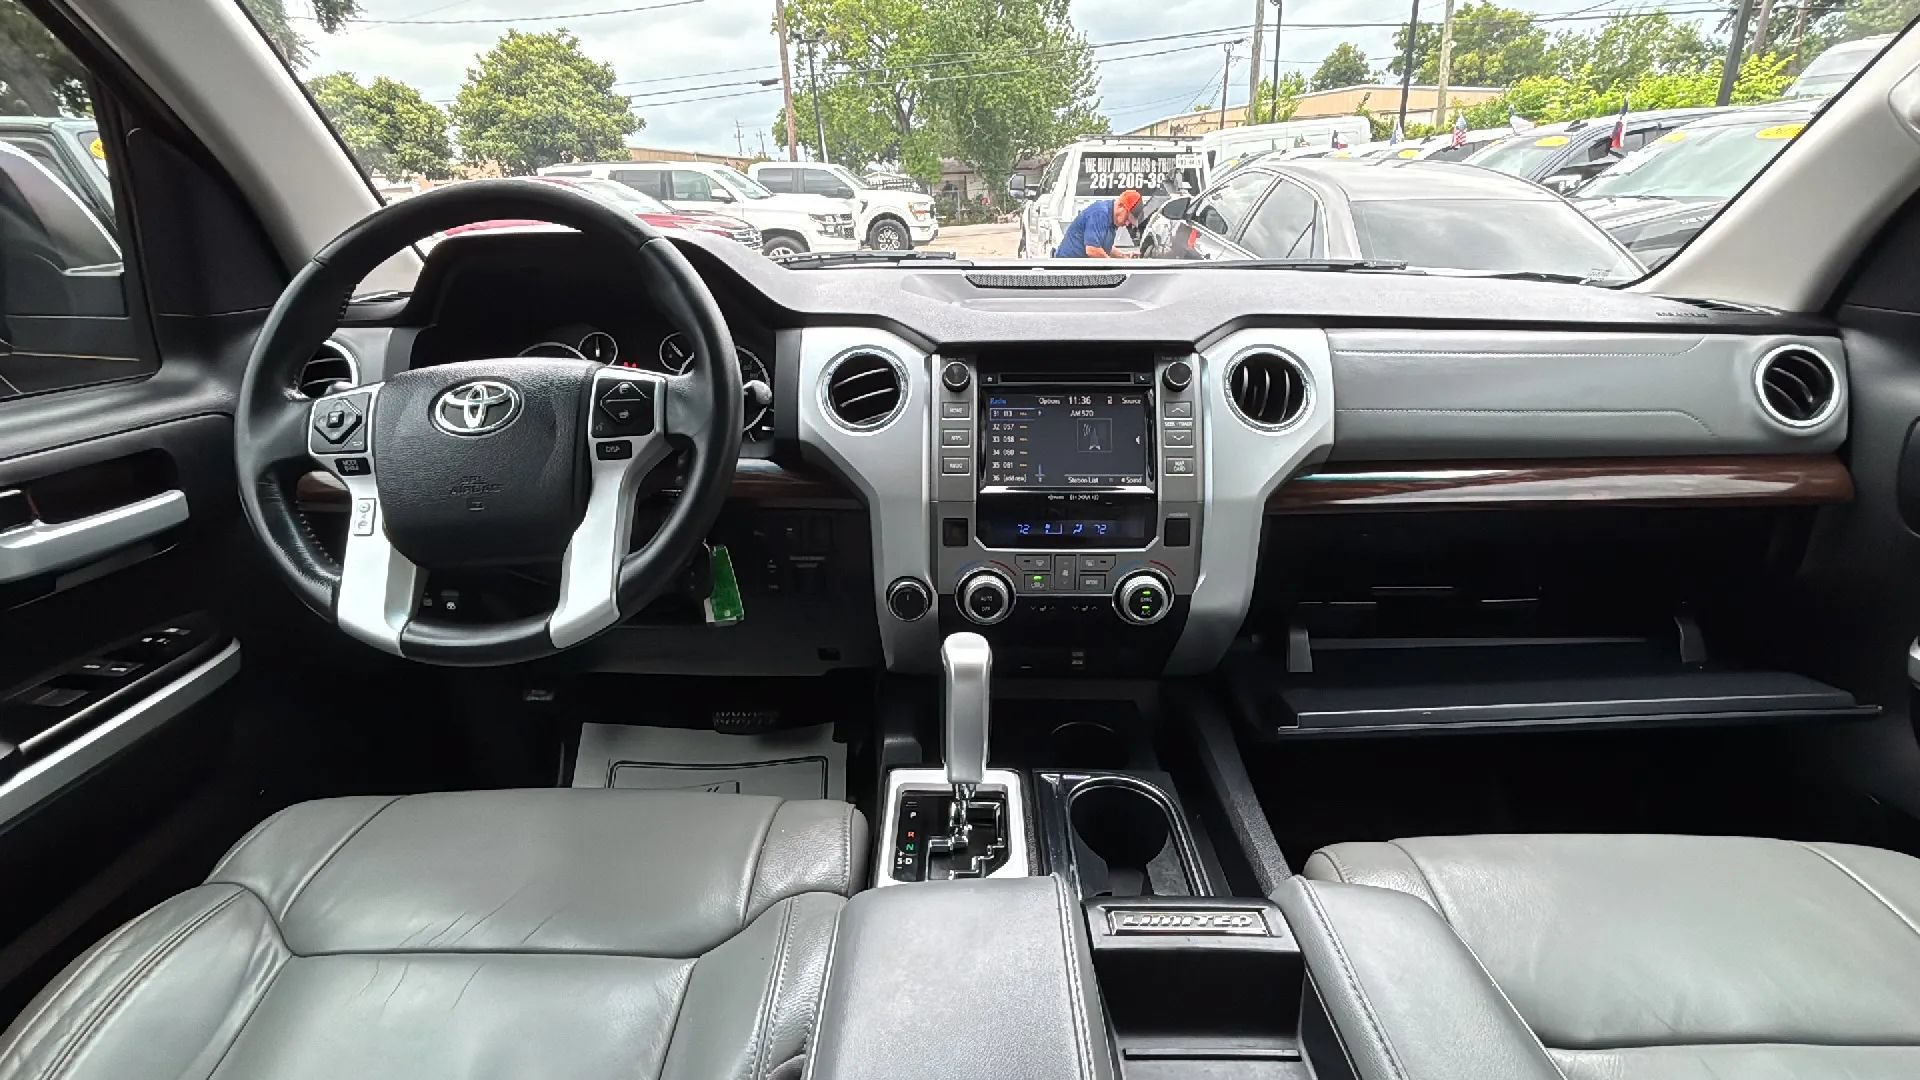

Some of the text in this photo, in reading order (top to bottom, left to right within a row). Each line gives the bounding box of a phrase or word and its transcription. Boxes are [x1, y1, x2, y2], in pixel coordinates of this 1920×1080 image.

[1085, 157, 1097, 173] WE
[1098, 157, 1112, 173] BUY
[1112, 157, 1130, 173] JUNK
[1132, 157, 1151, 173] CARS
[1151, 159, 1158, 173] &
[1158, 157, 1184, 173] TRUC
[1090, 173, 1165, 189] 281-206-39
[990, 397, 1007, 405] Radio
[1039, 397, 1060, 406] Options
[1069, 396, 1091, 405] 11:36
[1121, 397, 1141, 405] Source
[1017, 523, 1030, 535] 72
[1094, 523, 1108, 535] 72
[1123, 914, 1253, 928] LIMITED
